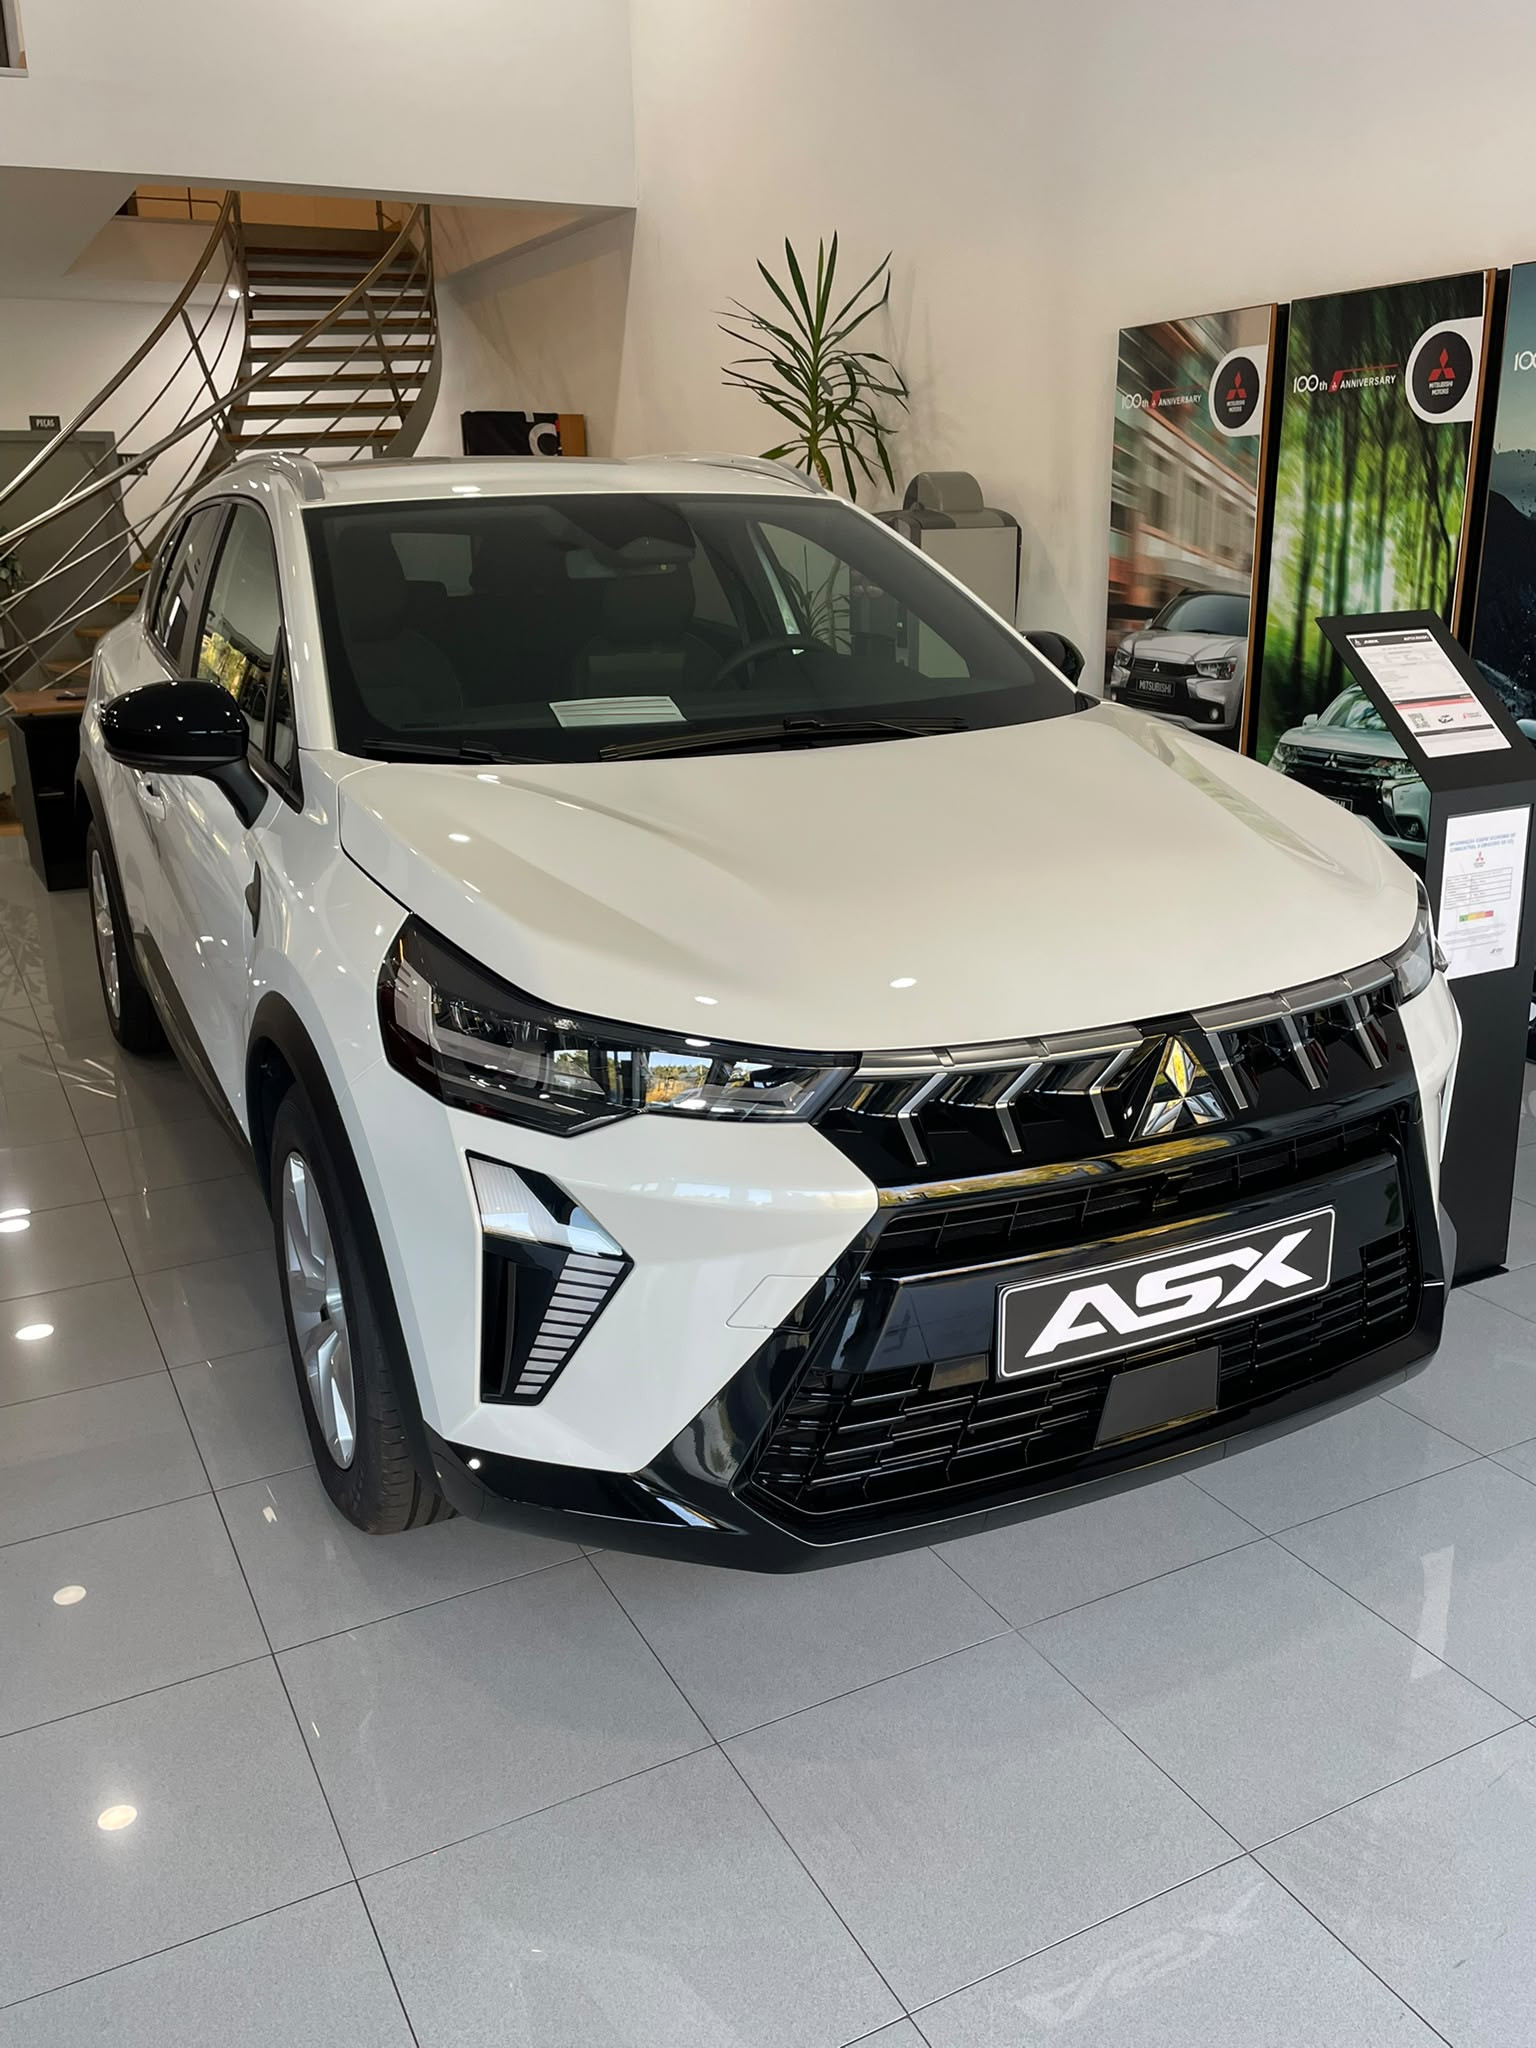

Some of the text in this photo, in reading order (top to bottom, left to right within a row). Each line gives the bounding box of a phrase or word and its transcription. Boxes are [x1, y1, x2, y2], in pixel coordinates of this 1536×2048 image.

[1293, 374, 1397, 394] 100th ANNIVERSARY
[1121, 393, 1202, 409] 100th ANNIVERSARY
[1024, 1228, 1313, 1358] ASX
